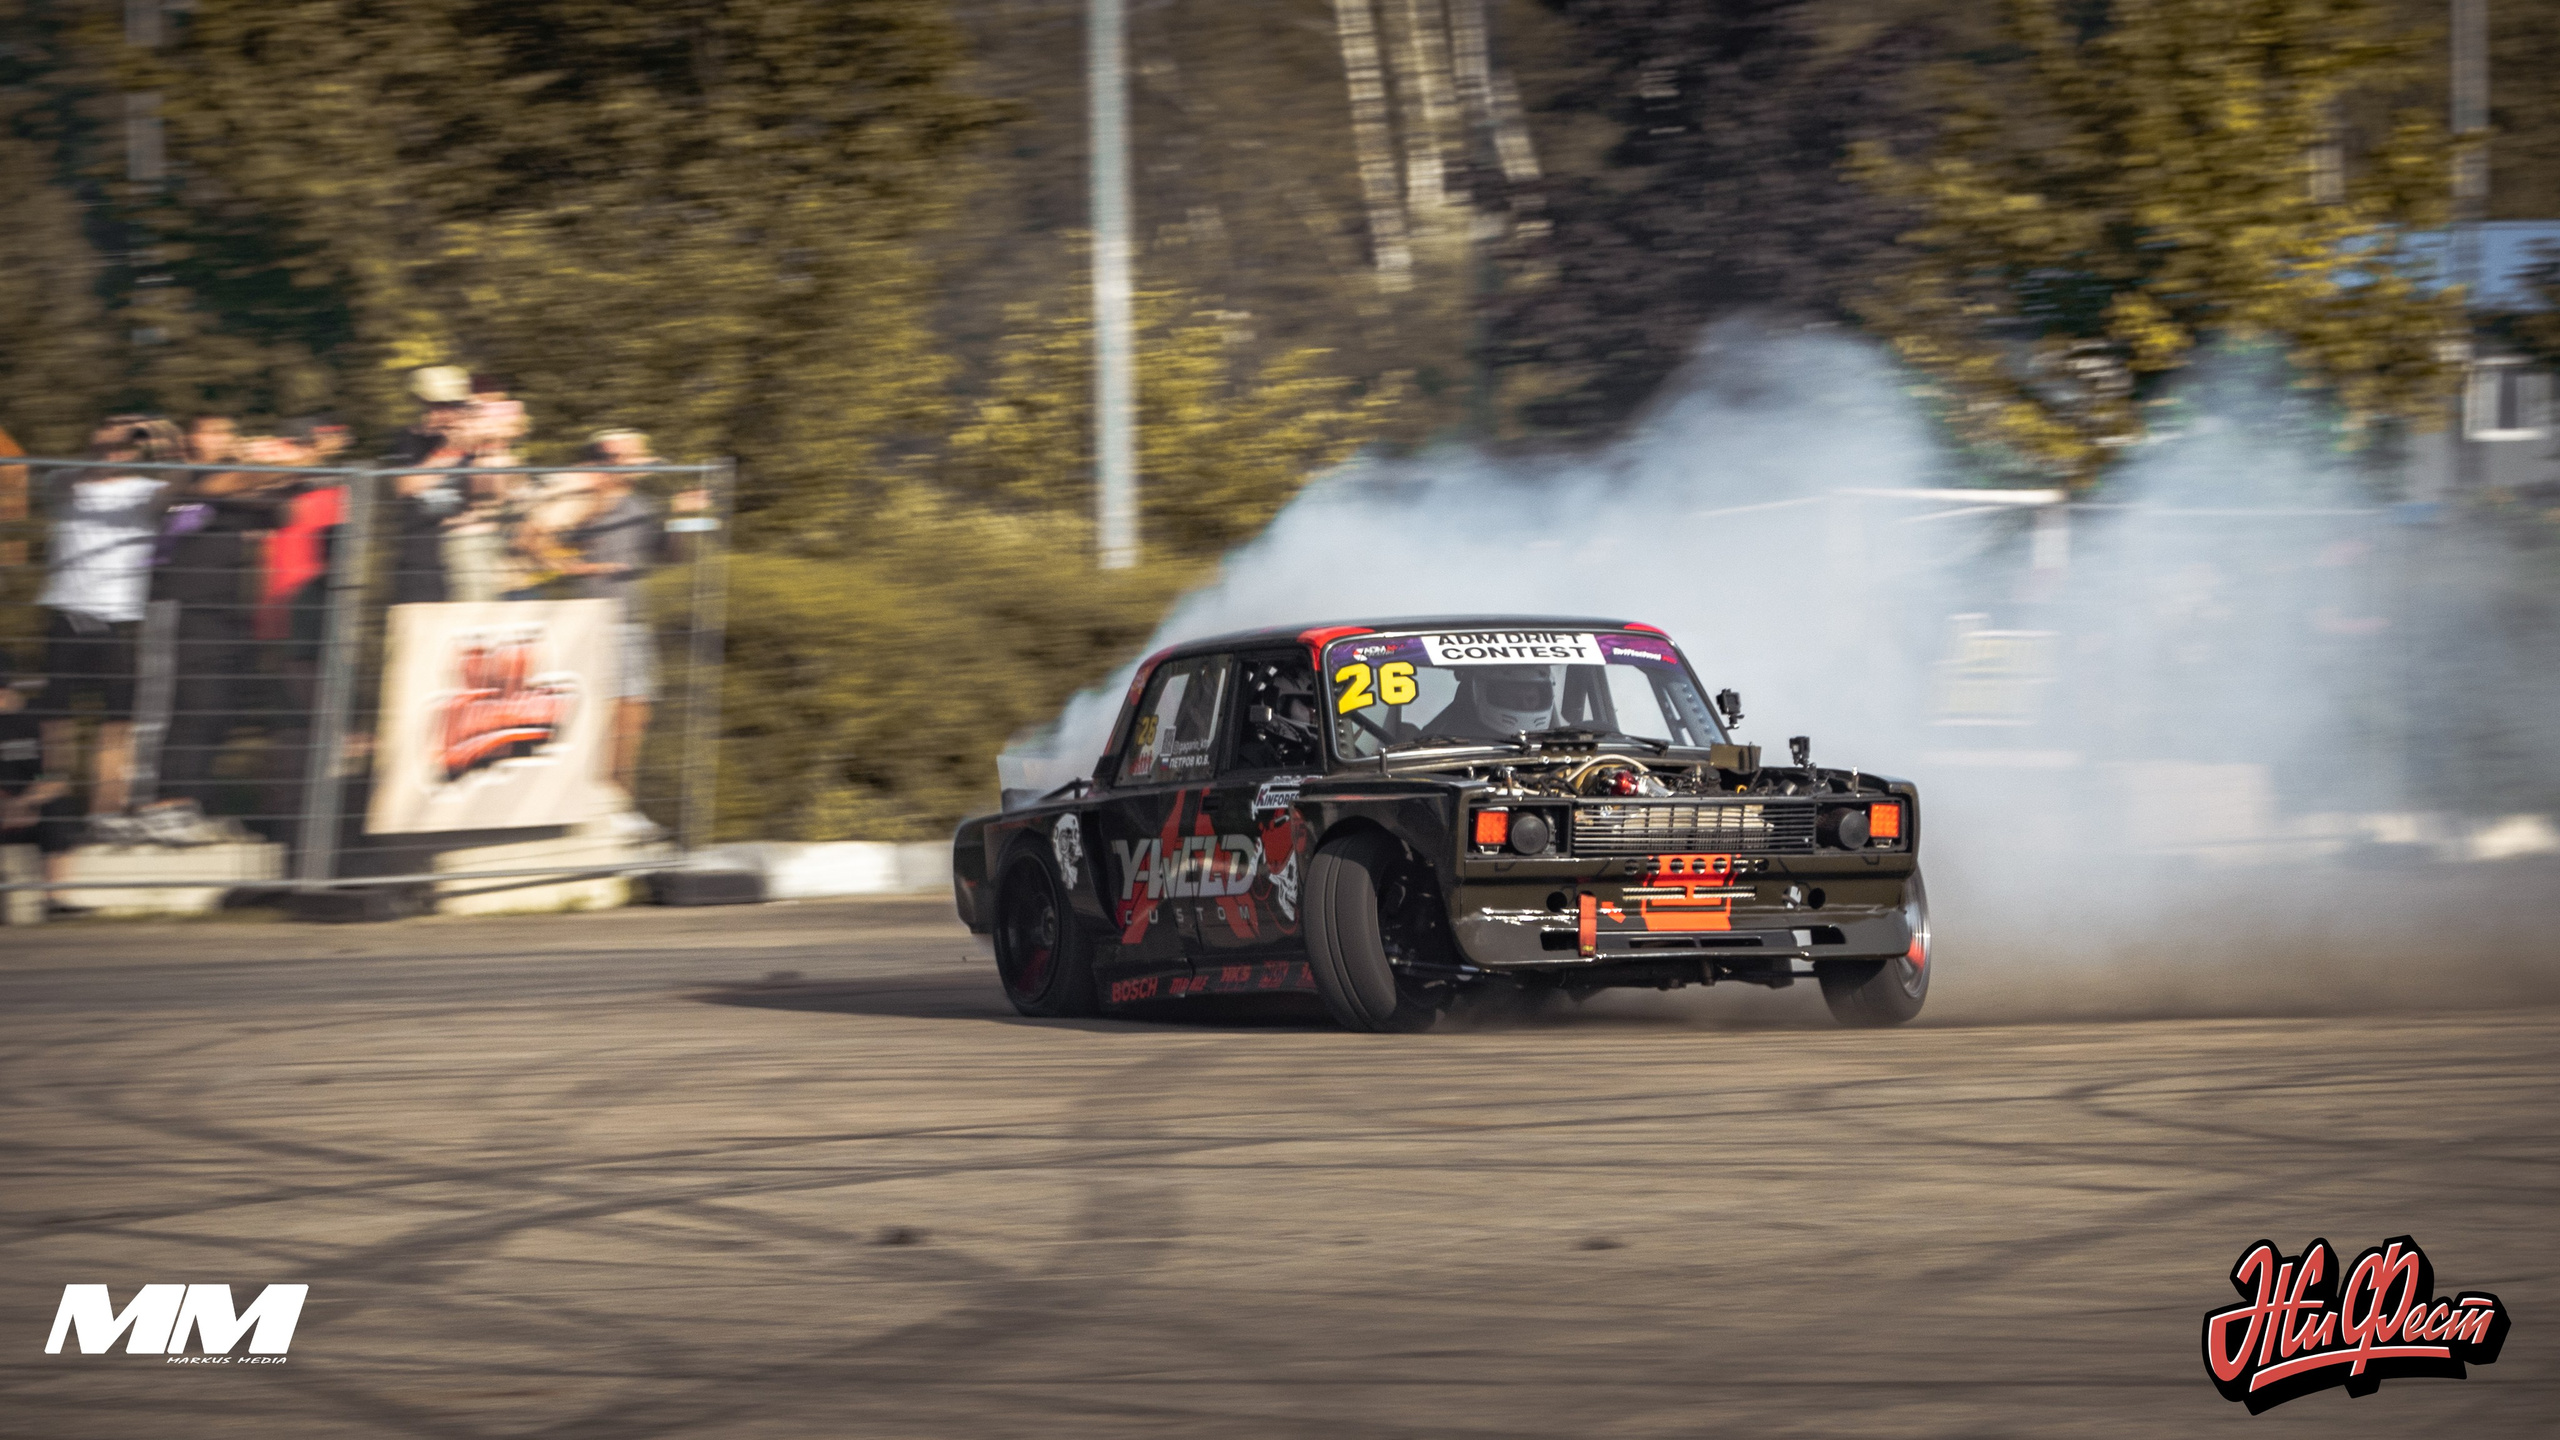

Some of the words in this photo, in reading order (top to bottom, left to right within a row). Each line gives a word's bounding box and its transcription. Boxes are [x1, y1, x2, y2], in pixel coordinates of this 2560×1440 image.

[1438, 634, 1499, 646] ADM
[1506, 633, 1581, 644] DRIFT
[1441, 646, 1587, 660] CONTEST
[1335, 661, 1417, 715] 26
[1168, 755, 1195, 769] ПЕТРОВ
[1111, 834, 1256, 900] Y-WELD
[1125, 906, 1250, 925] CUSTOM
[1112, 977, 1158, 1003] BOSCH
